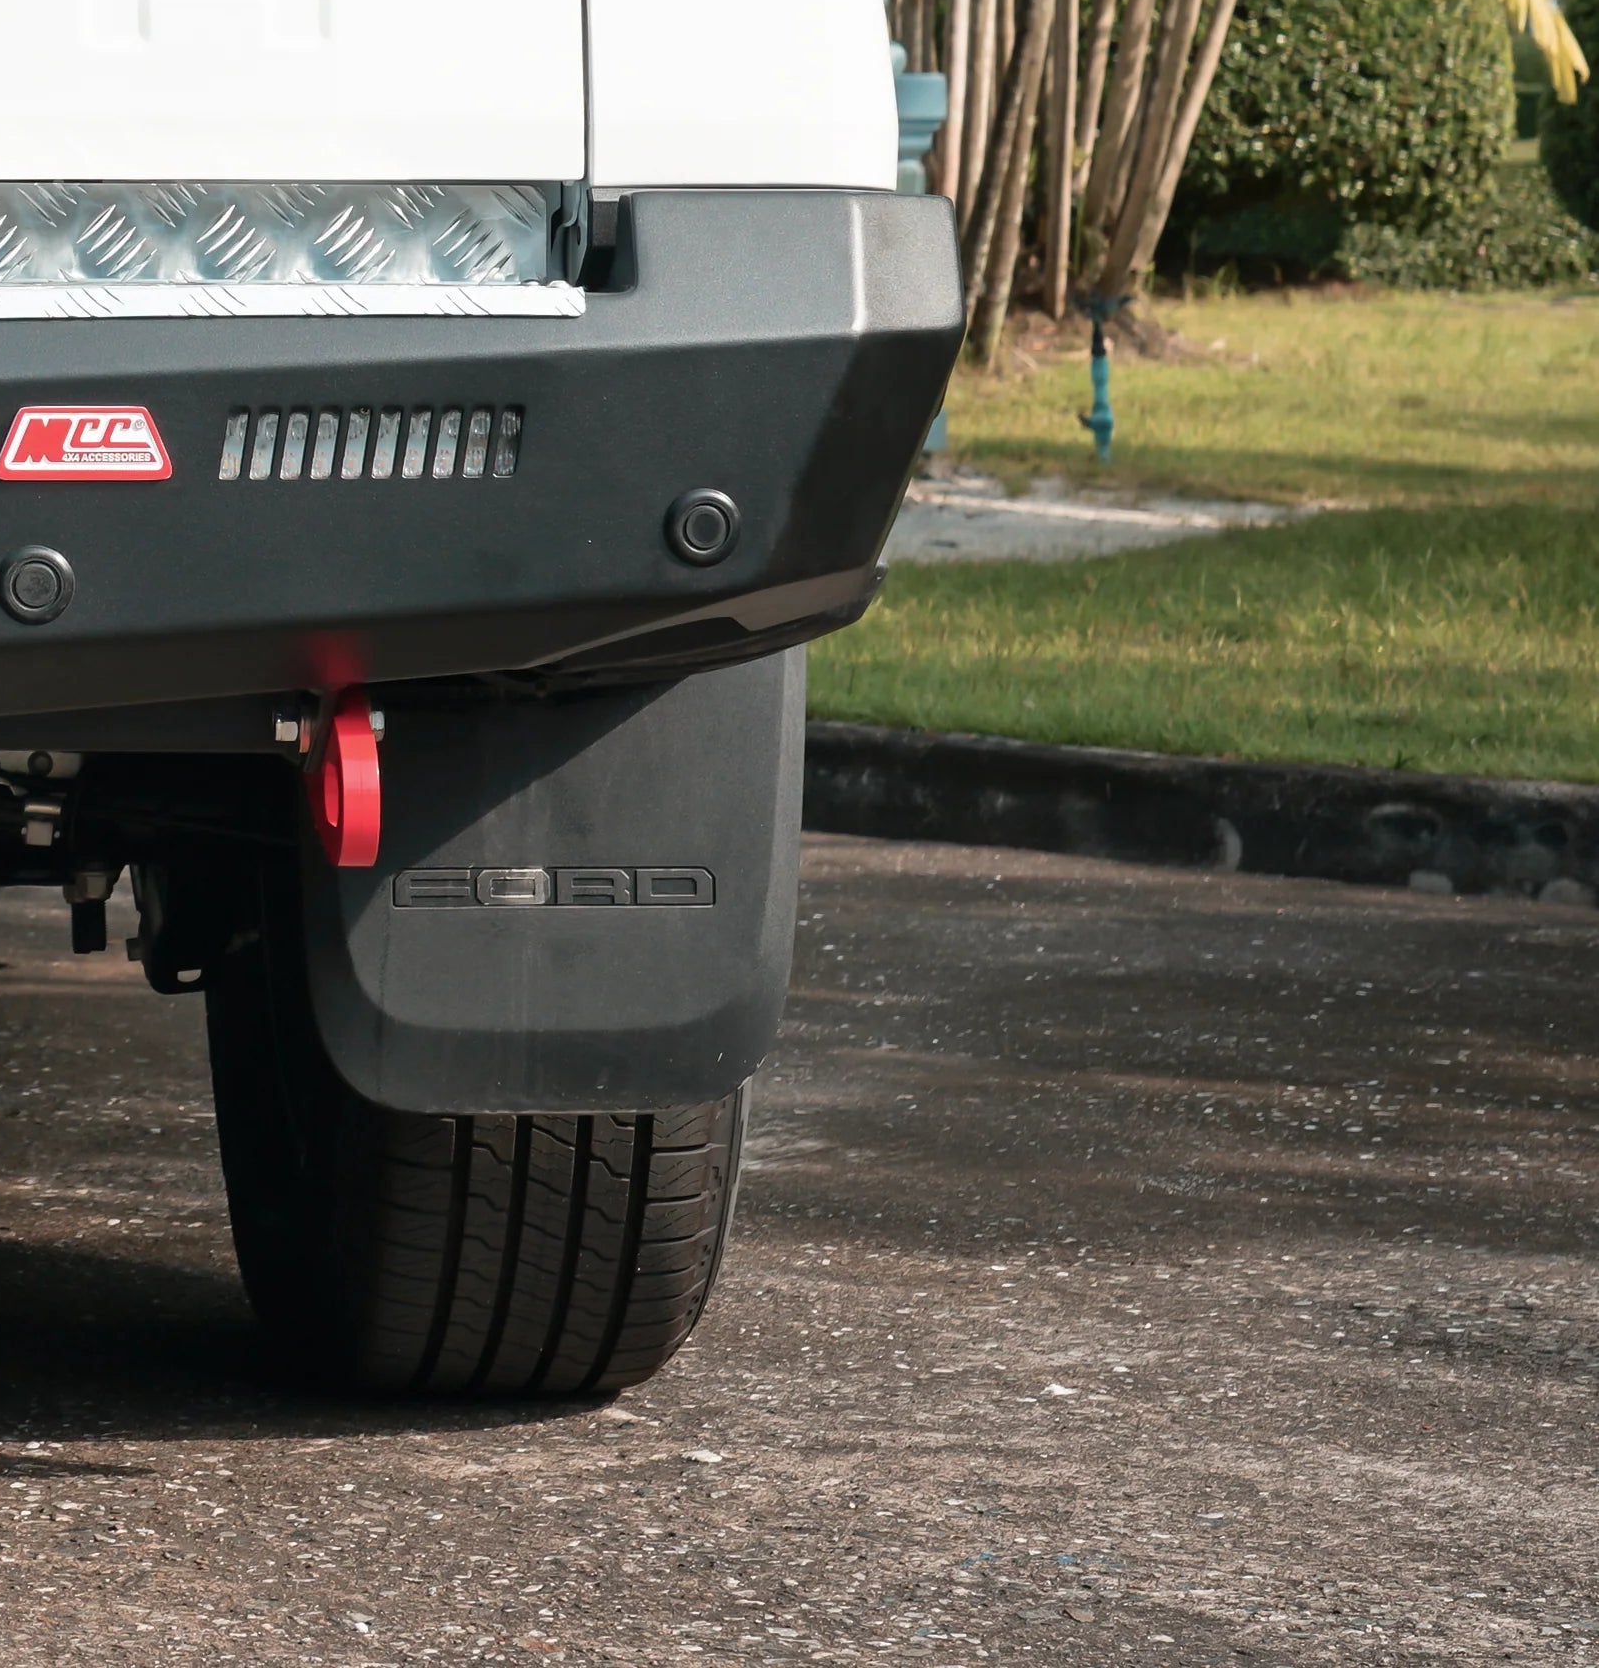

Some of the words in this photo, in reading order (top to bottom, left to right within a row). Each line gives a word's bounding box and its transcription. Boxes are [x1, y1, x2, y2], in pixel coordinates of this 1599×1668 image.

[12, 418, 151, 463] MCC
[81, 452, 151, 462] ACCESSORIES
[394, 867, 715, 908] FORD
